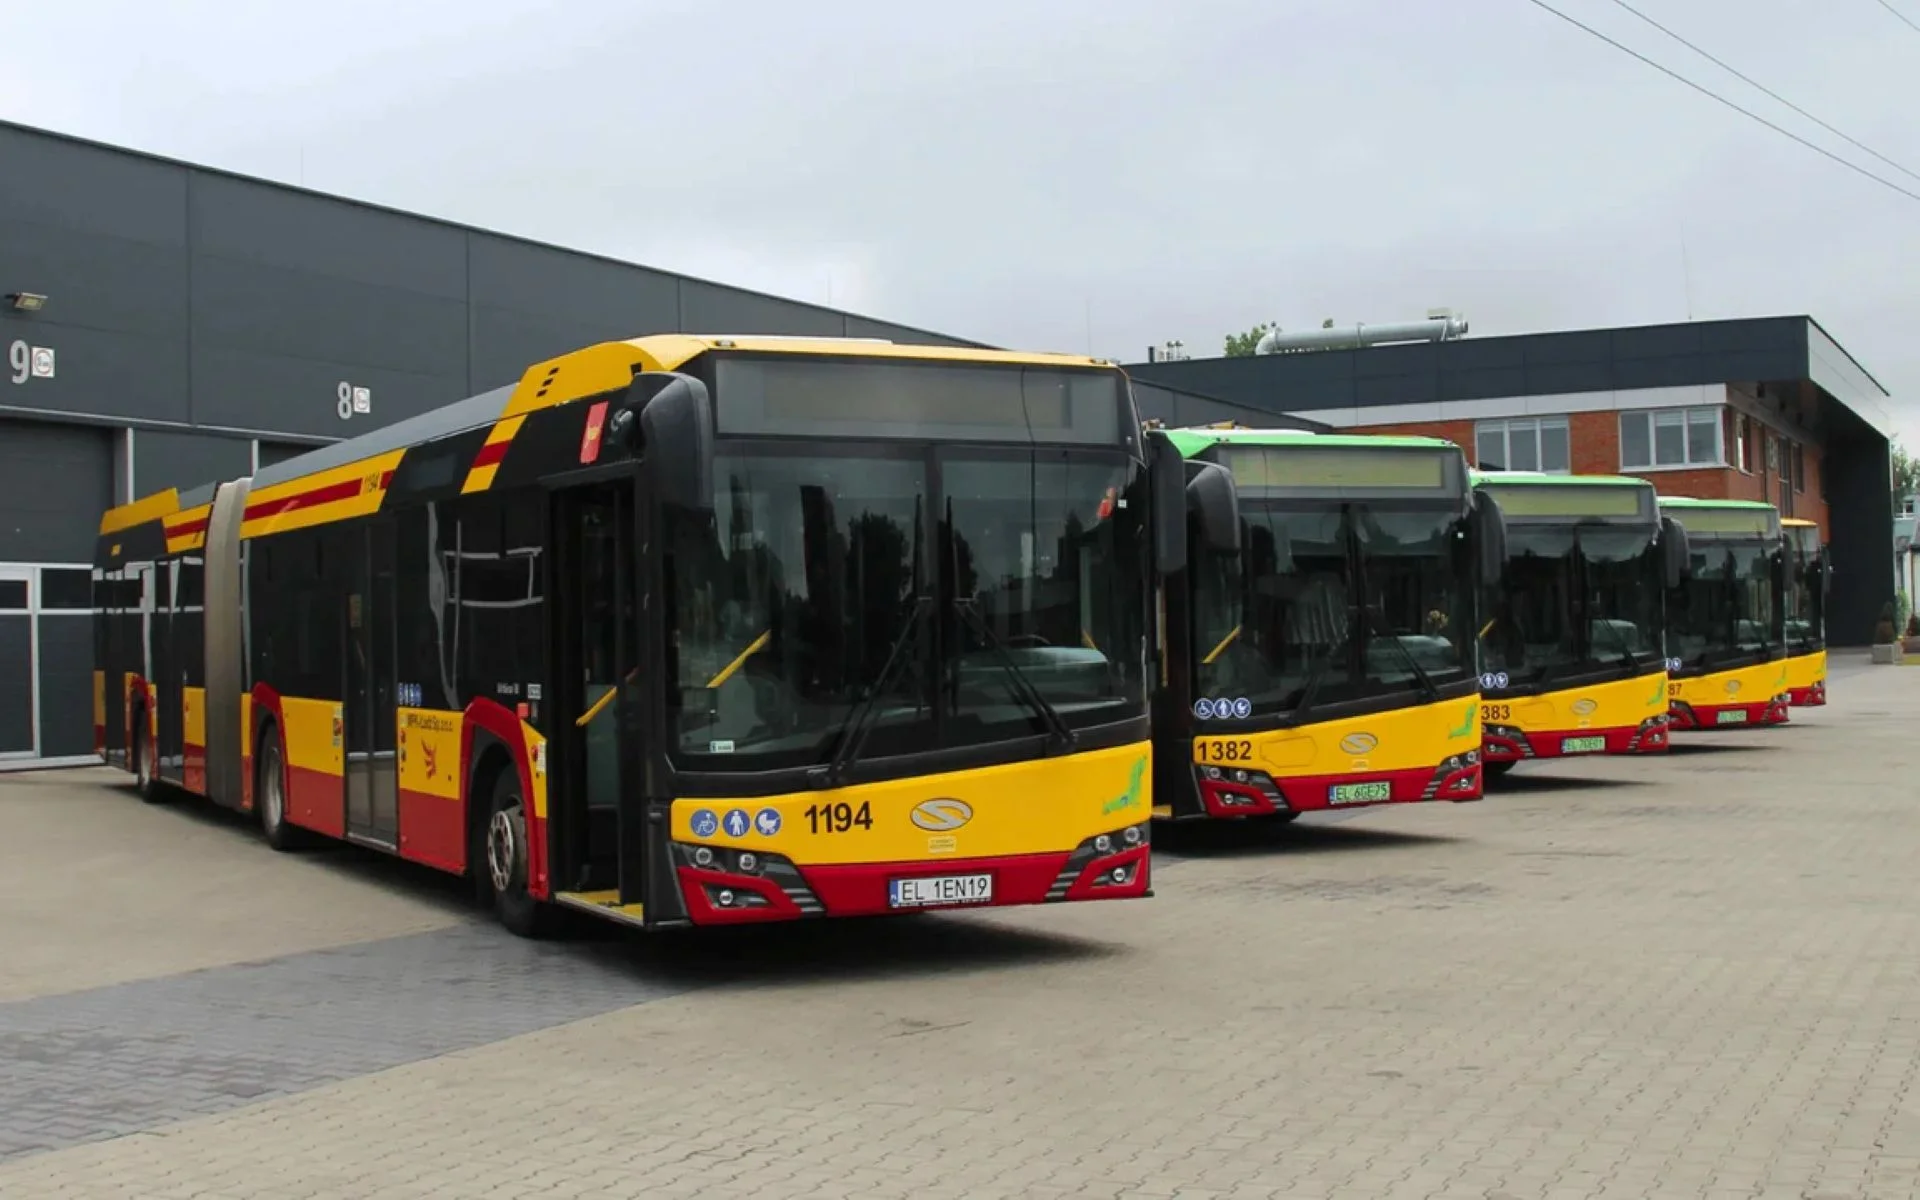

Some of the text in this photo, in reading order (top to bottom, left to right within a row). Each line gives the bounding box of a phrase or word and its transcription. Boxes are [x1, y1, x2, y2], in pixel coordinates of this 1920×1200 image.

[10, 340, 30, 384] 9
[337, 381, 352, 419] 8
[1197, 741, 1252, 761] 1382
[1336, 787, 1351, 800] EL
[805, 801, 873, 834] 1194
[902, 878, 987, 900] EL 1EN19
